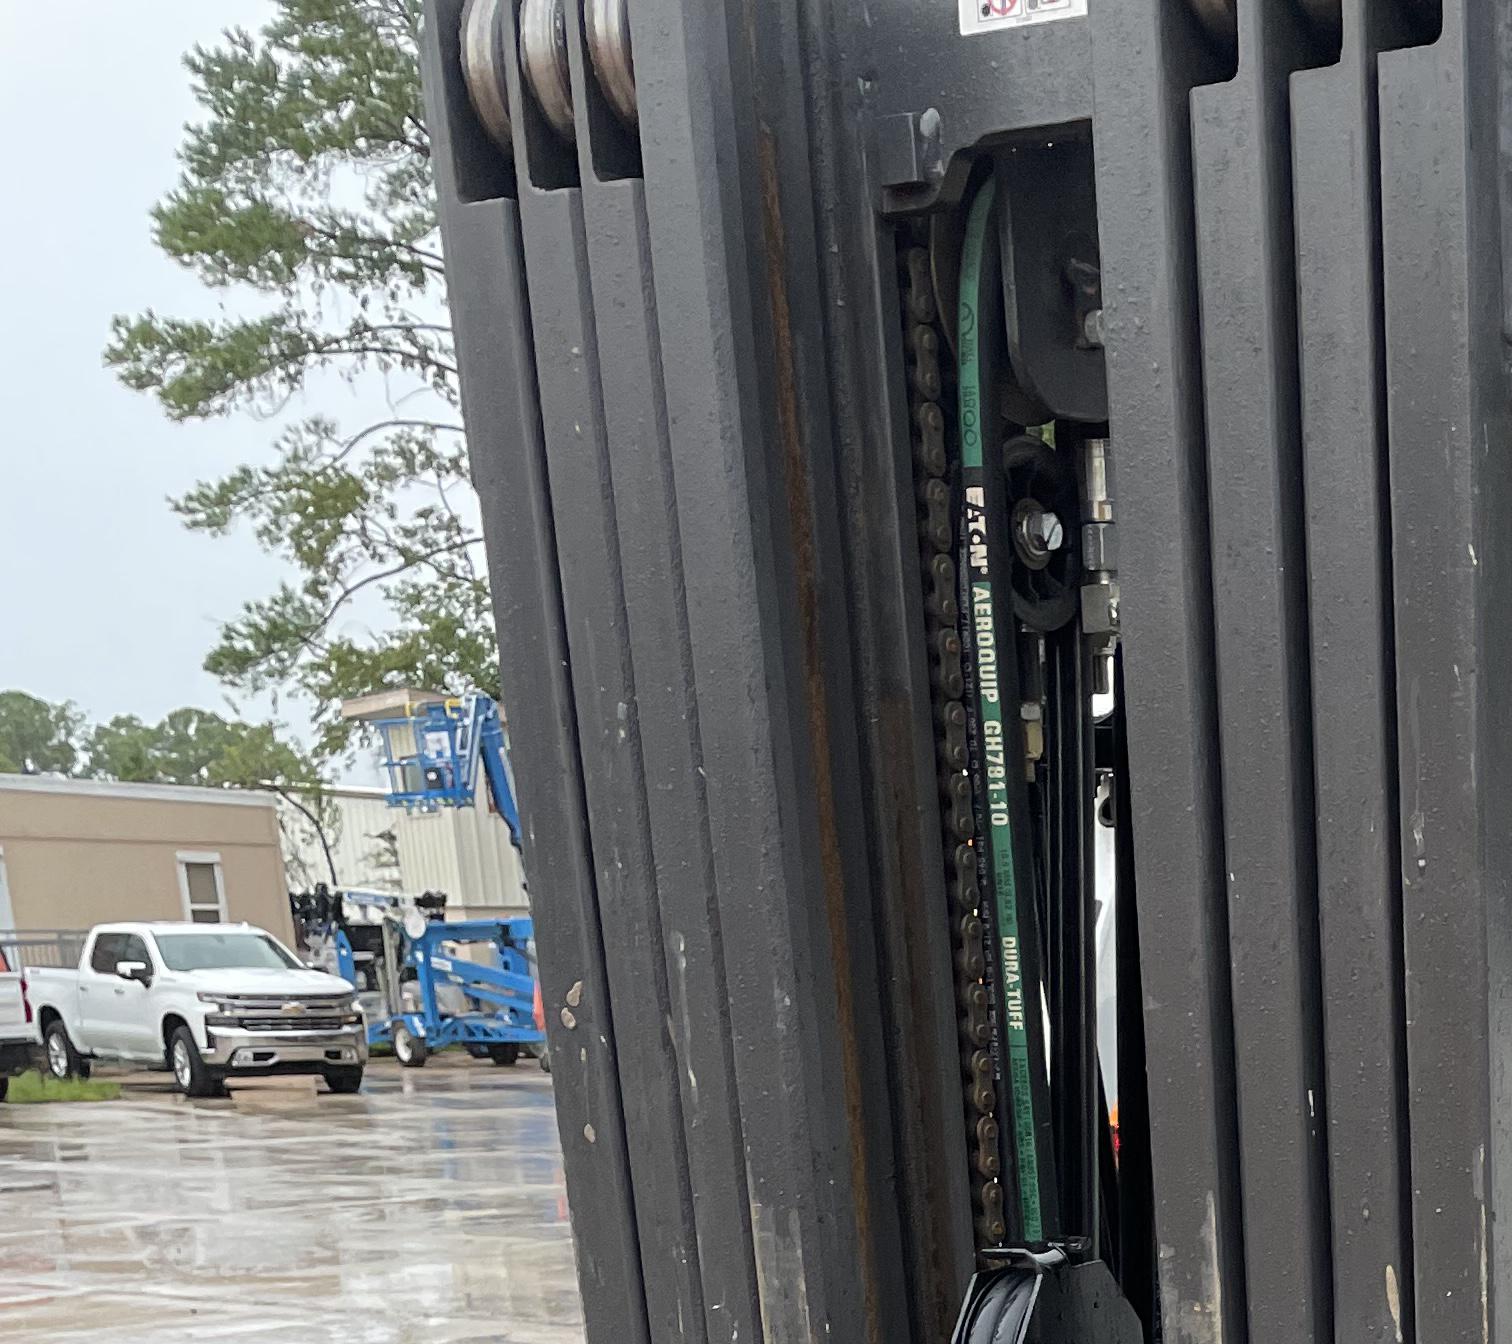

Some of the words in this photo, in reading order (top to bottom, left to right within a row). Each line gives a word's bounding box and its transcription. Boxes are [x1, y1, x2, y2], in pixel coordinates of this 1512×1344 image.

[971, 586, 998, 704] AEROQUIP
[984, 720, 1010, 827] GH781-10
[1001, 936, 1025, 1031] DURA-TUFF
